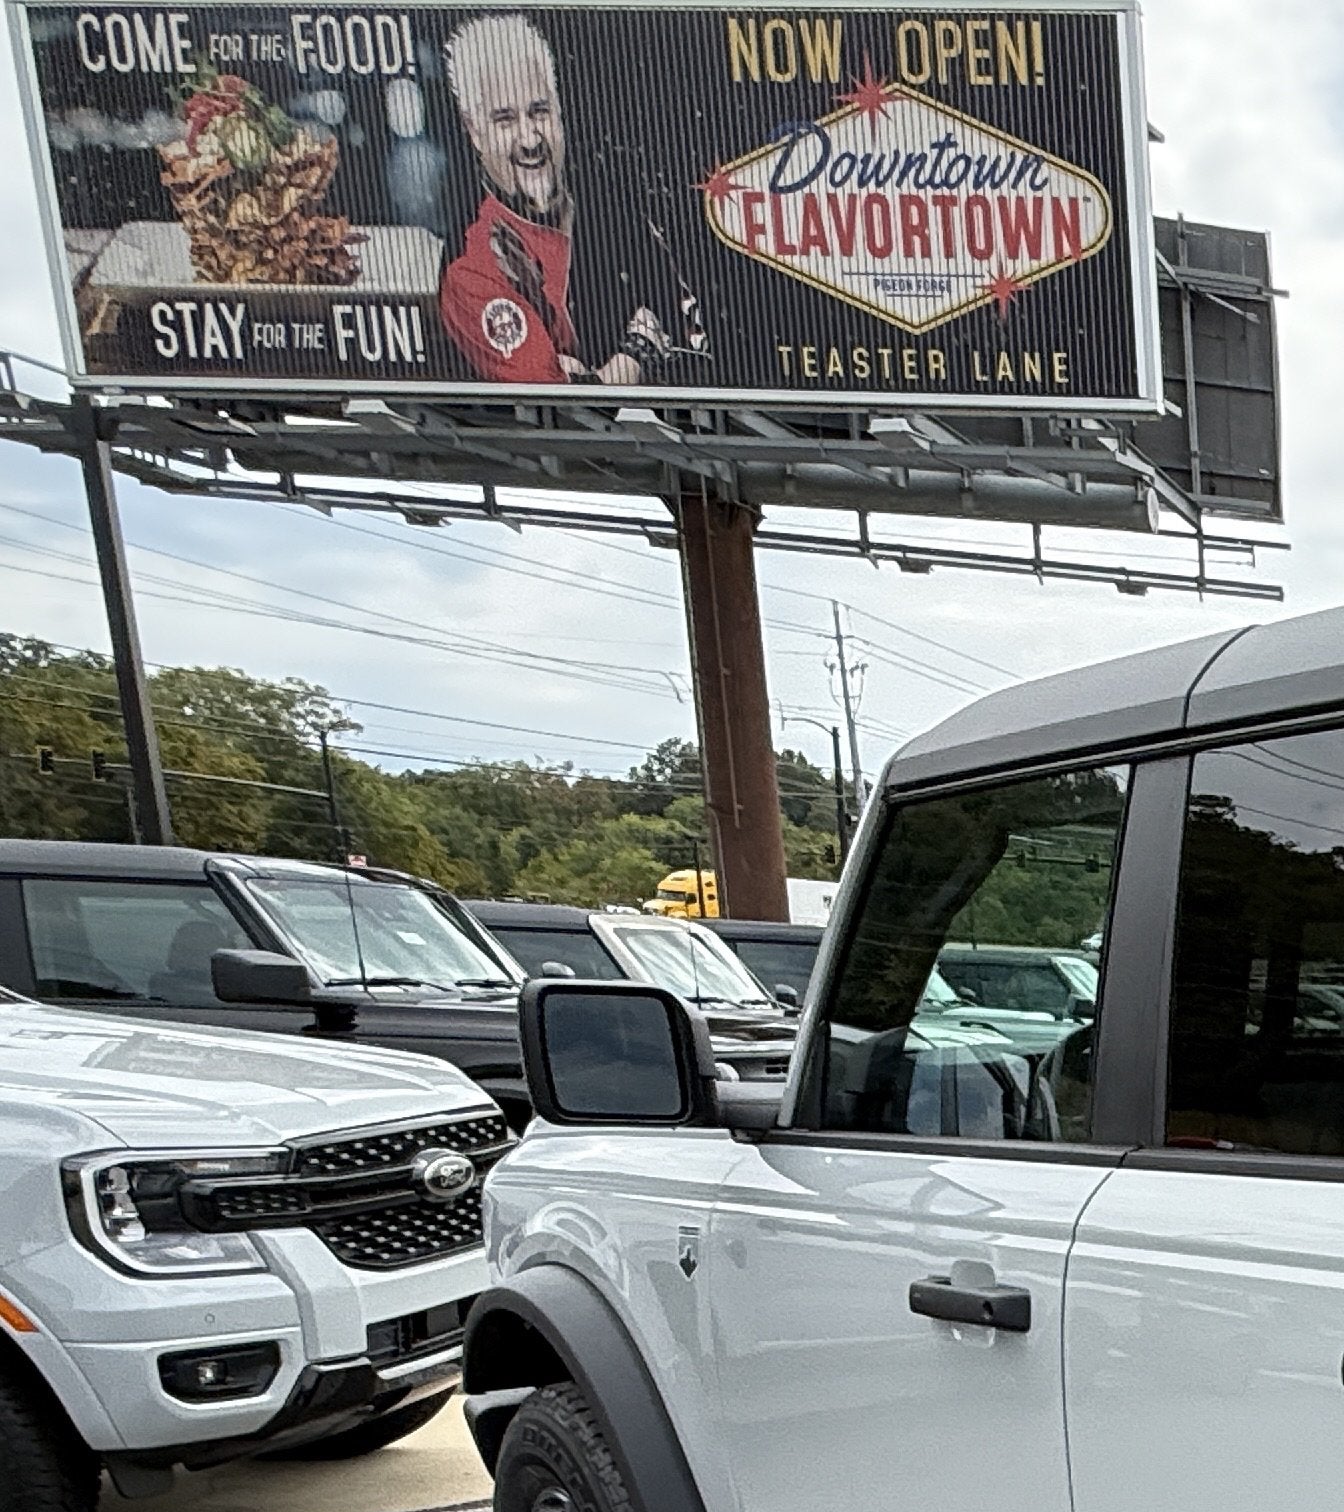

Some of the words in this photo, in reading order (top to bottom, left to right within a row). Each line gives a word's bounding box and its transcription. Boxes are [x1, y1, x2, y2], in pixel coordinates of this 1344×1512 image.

[77, 12, 197, 73] COME
[209, 33, 244, 61] FOR
[250, 34, 286, 61] THE
[291, 13, 416, 75] FOOD!
[727, 18, 842, 84] NOW
[897, 19, 1045, 86] OPEN!
[766, 120, 1049, 194] Downtown
[742, 191, 1083, 263] FLAVORTOWN
[150, 301, 247, 360] STAY
[252, 322, 287, 350] FOR
[291, 322, 326, 350] THE
[332, 304, 427, 363] FUN!
[777, 345, 947, 381] TEASTER
[973, 350, 1071, 384] LANE
